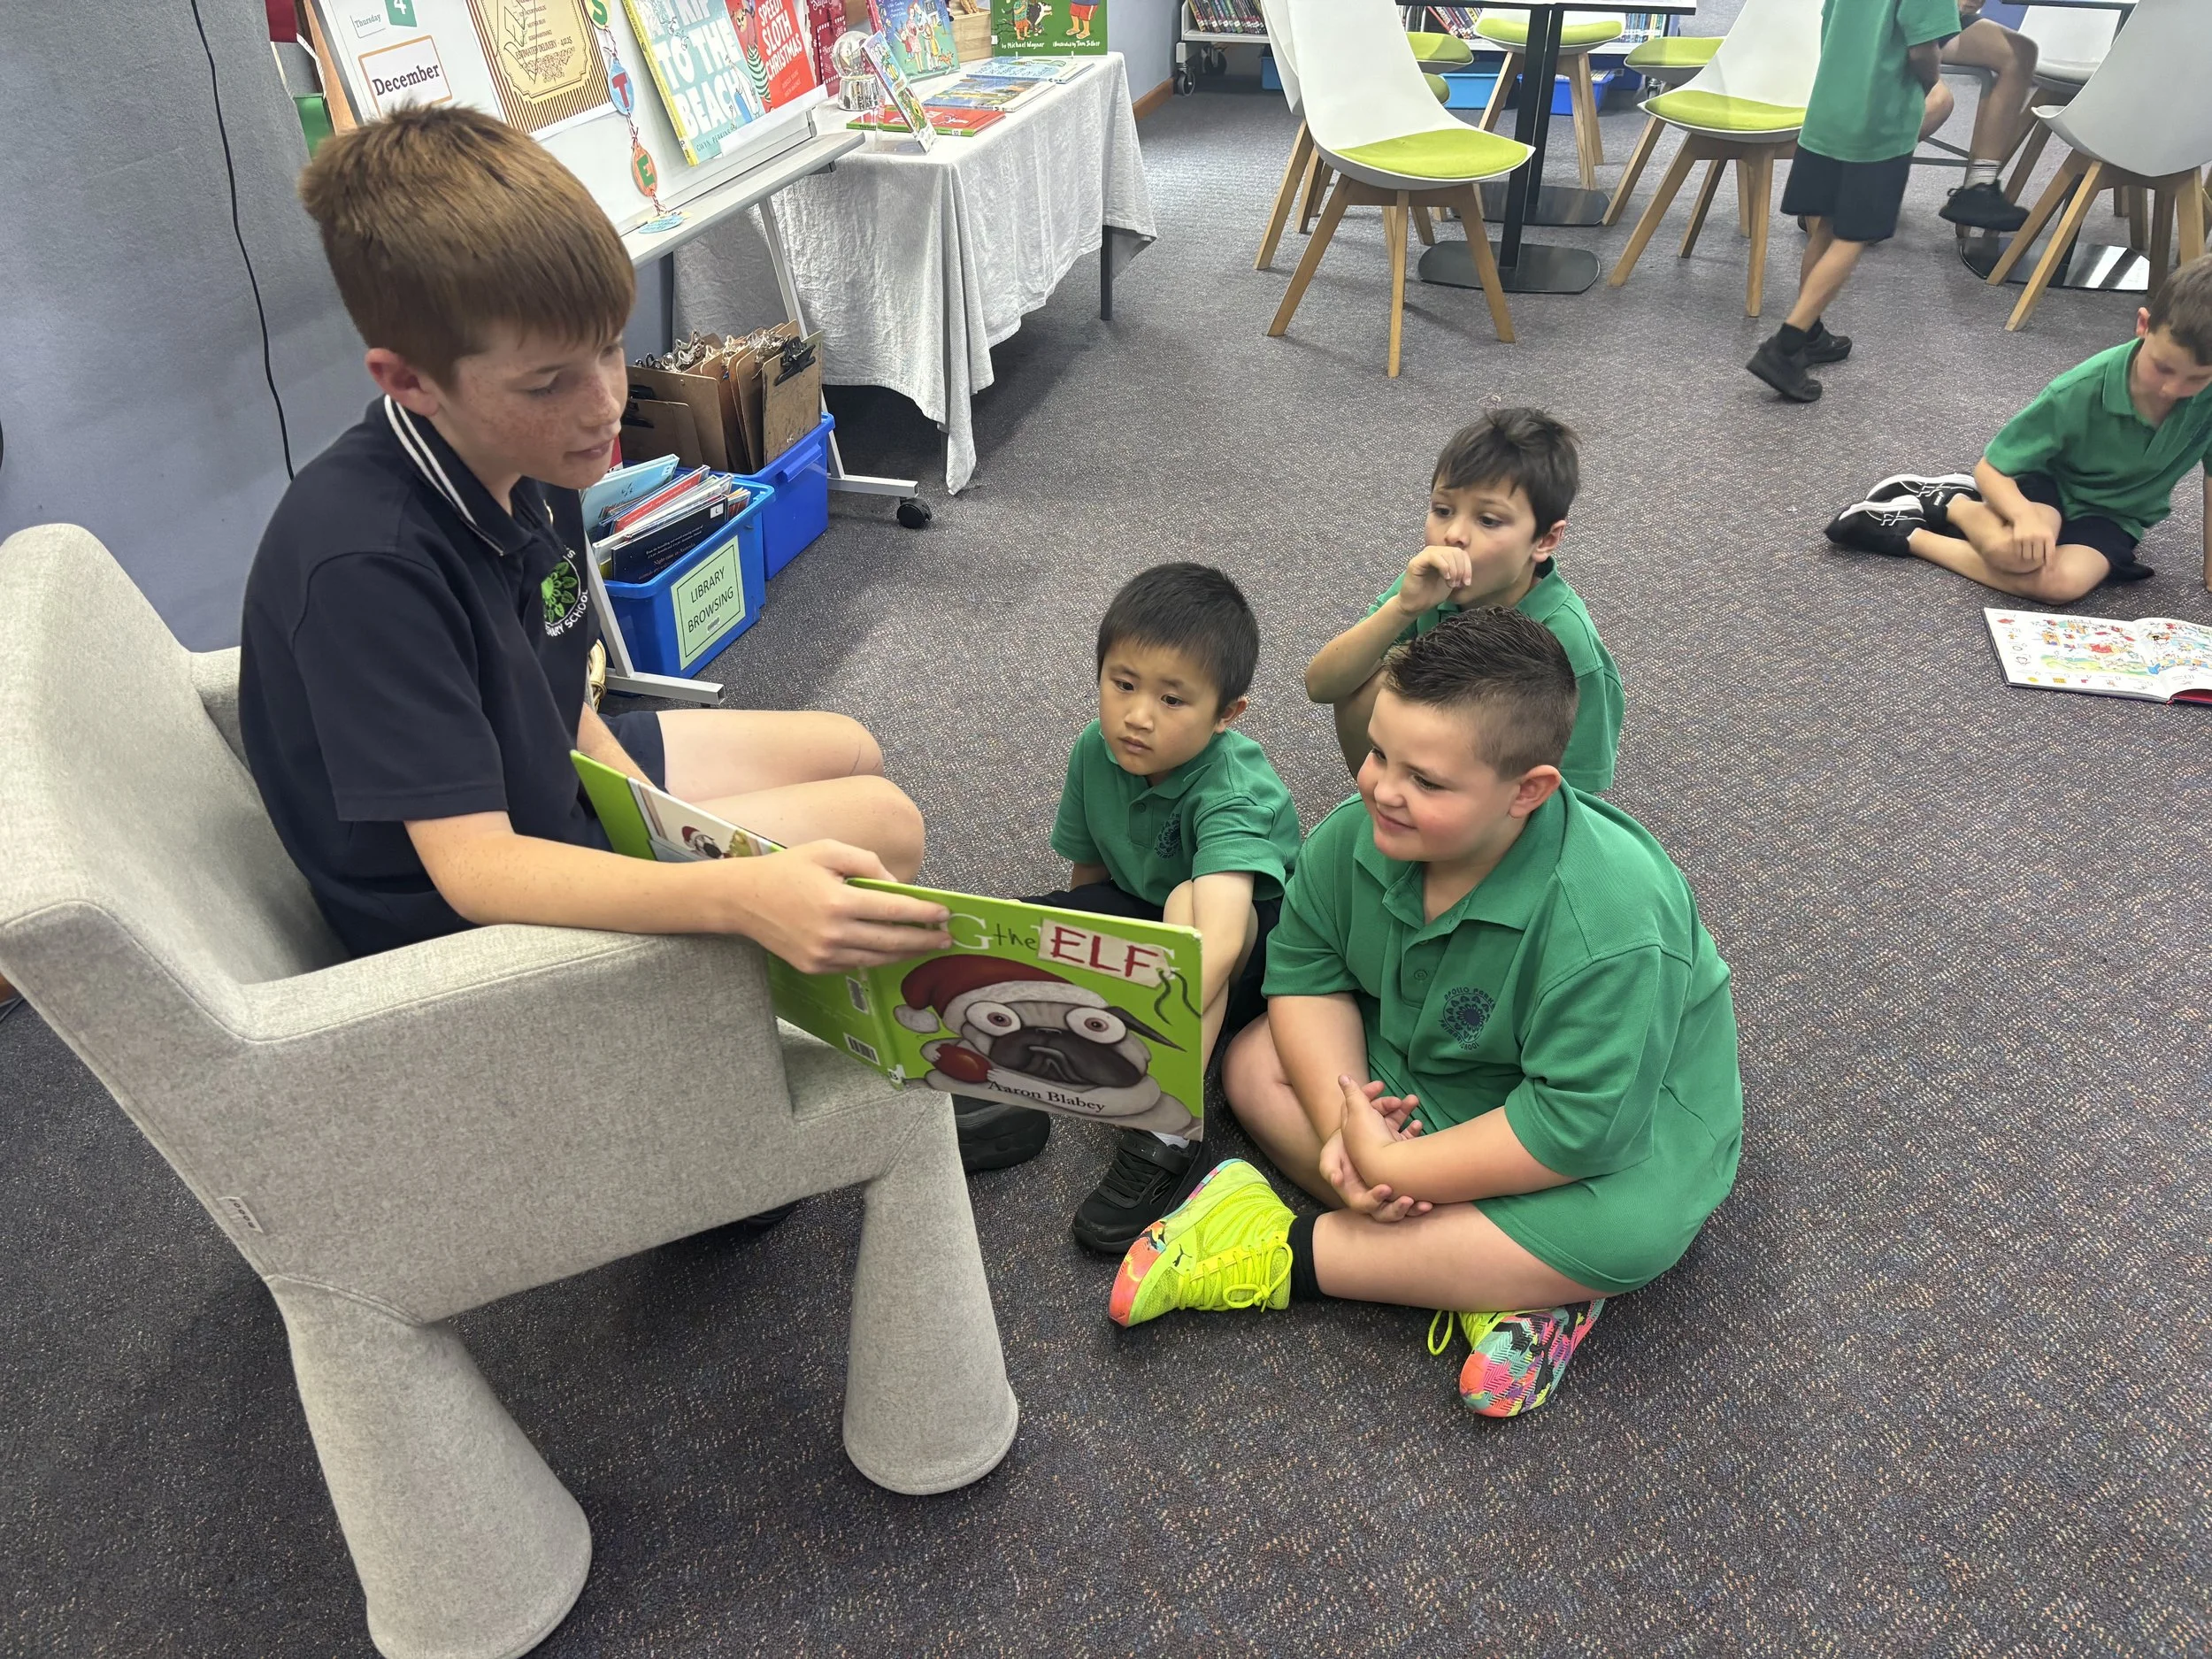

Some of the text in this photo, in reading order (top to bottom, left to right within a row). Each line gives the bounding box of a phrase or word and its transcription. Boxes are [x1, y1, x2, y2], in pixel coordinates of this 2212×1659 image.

[354, 13, 381, 28] Thursday
[762, 10, 793, 56] SLOTH
[652, 17, 741, 89] TO THE
[765, 33, 803, 81] CHRISTMAS
[373, 65, 440, 96] December
[611, 73, 629, 109] T
[672, 69, 742, 139] BEACH
[637, 154, 655, 188] E
[690, 565, 726, 604] LIBRARY
[565, 588, 588, 628] SCHOOL
[687, 587, 734, 634] BROWSING
[993, 923, 1039, 951] the
[1050, 926, 1160, 978] ELF
[1444, 987, 1470, 1001] APOLLO
[988, 1080, 1105, 1113] Aaron Blabey
